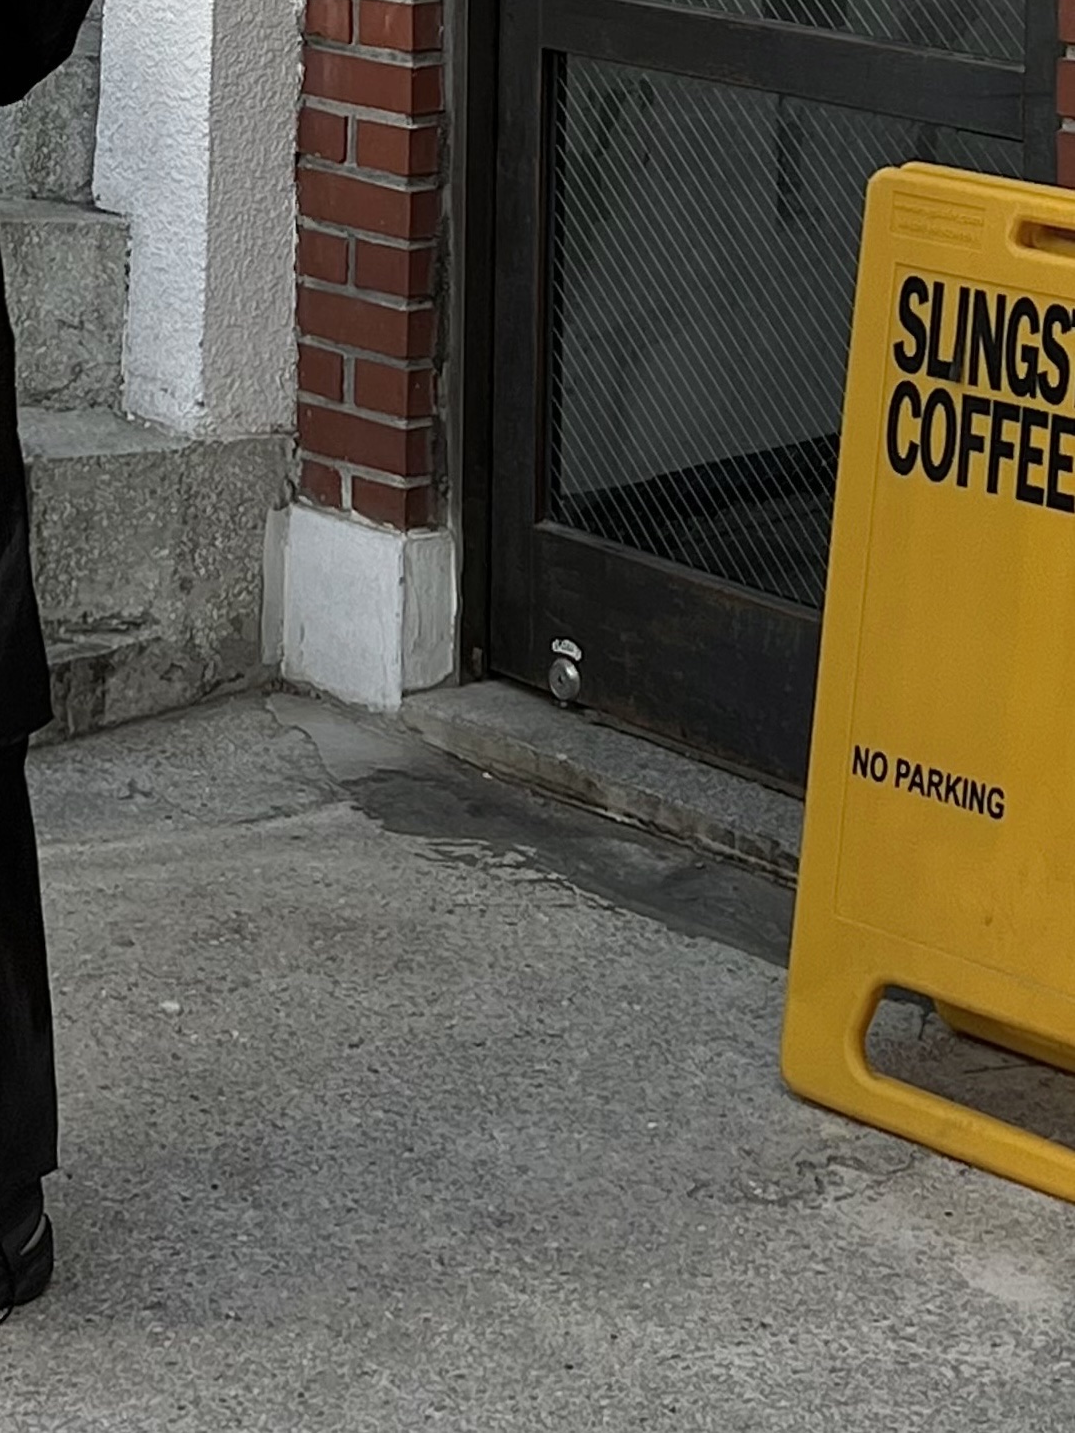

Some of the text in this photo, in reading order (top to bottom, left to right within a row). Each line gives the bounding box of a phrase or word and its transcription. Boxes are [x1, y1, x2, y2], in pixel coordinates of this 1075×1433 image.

[893, 275, 1075, 405] SLINGS
[886, 380, 1075, 514] COFFEE
[852, 745, 1005, 820] NO PARKING
